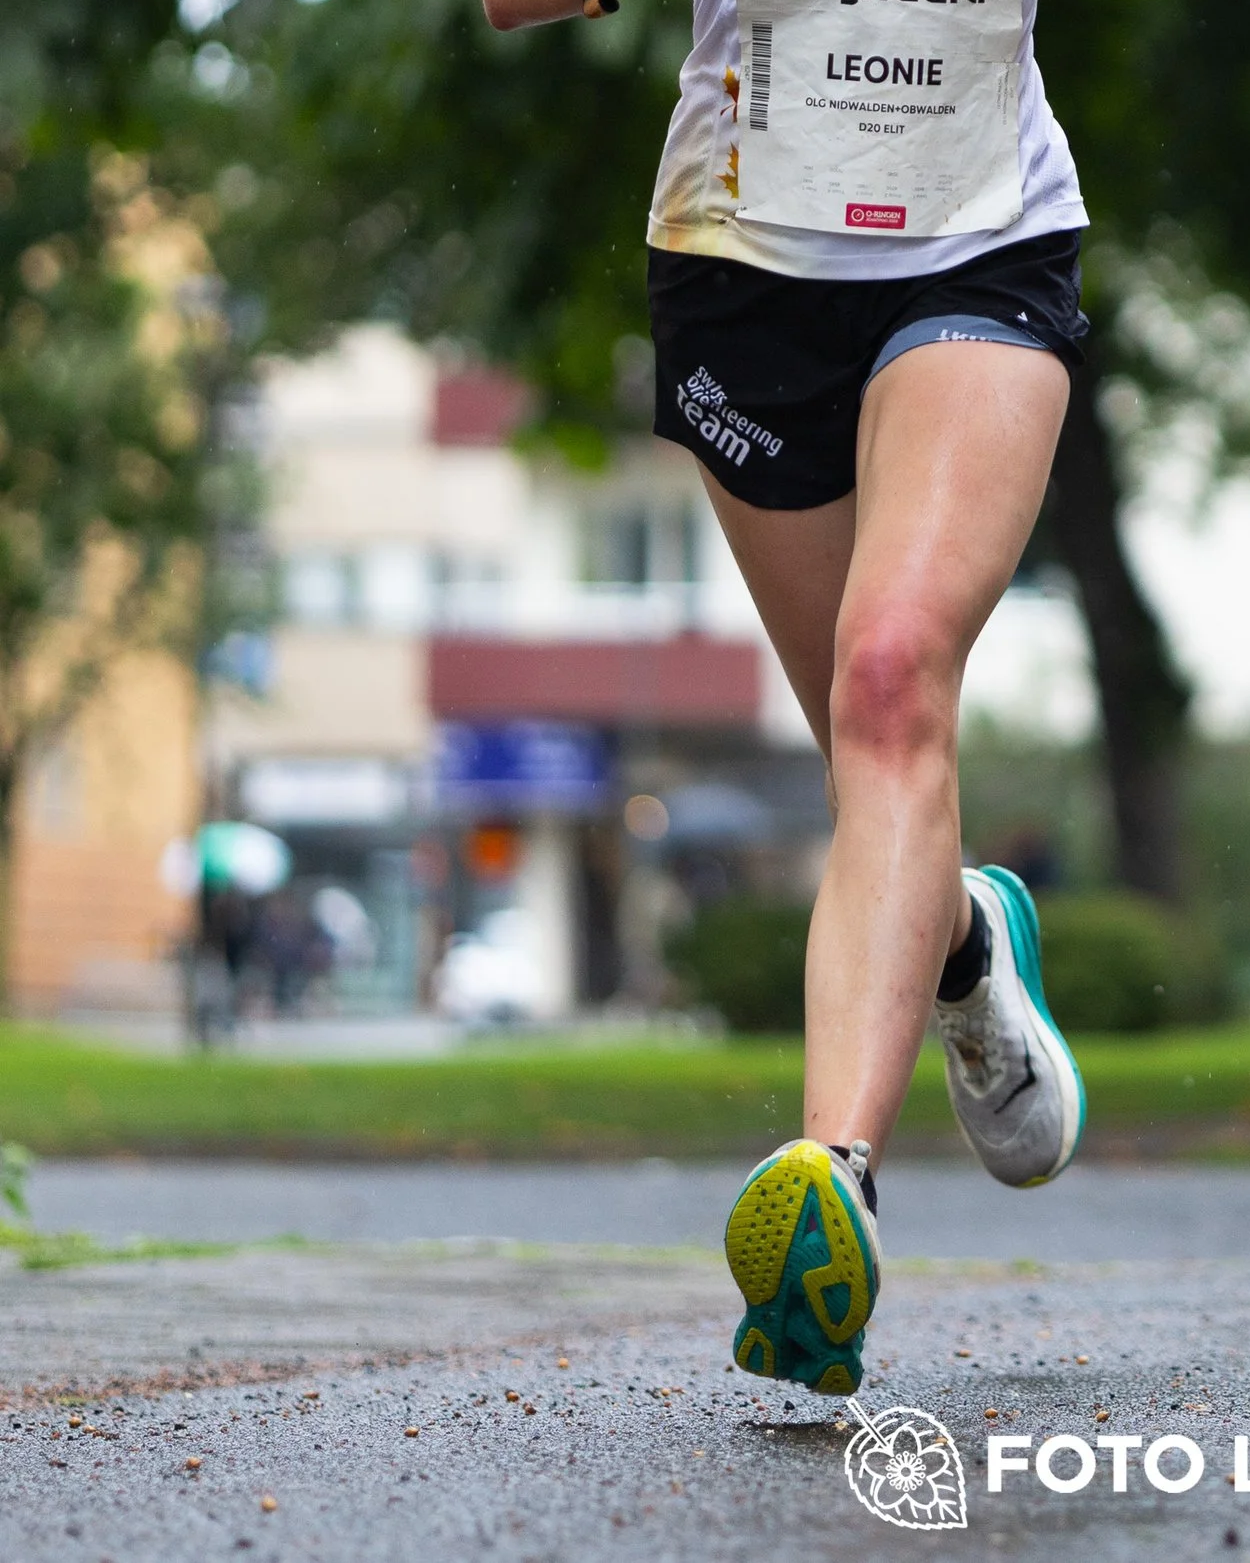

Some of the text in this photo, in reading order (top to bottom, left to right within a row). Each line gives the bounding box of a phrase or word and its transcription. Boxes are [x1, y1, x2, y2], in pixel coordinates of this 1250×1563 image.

[826, 53, 943, 86] LEONIE
[805, 97, 956, 115] OLG NIDWALDEN+OBWALDEN
[858, 123, 906, 135] D20 ELIT
[694, 365, 728, 406] swiss
[677, 383, 751, 467] team
